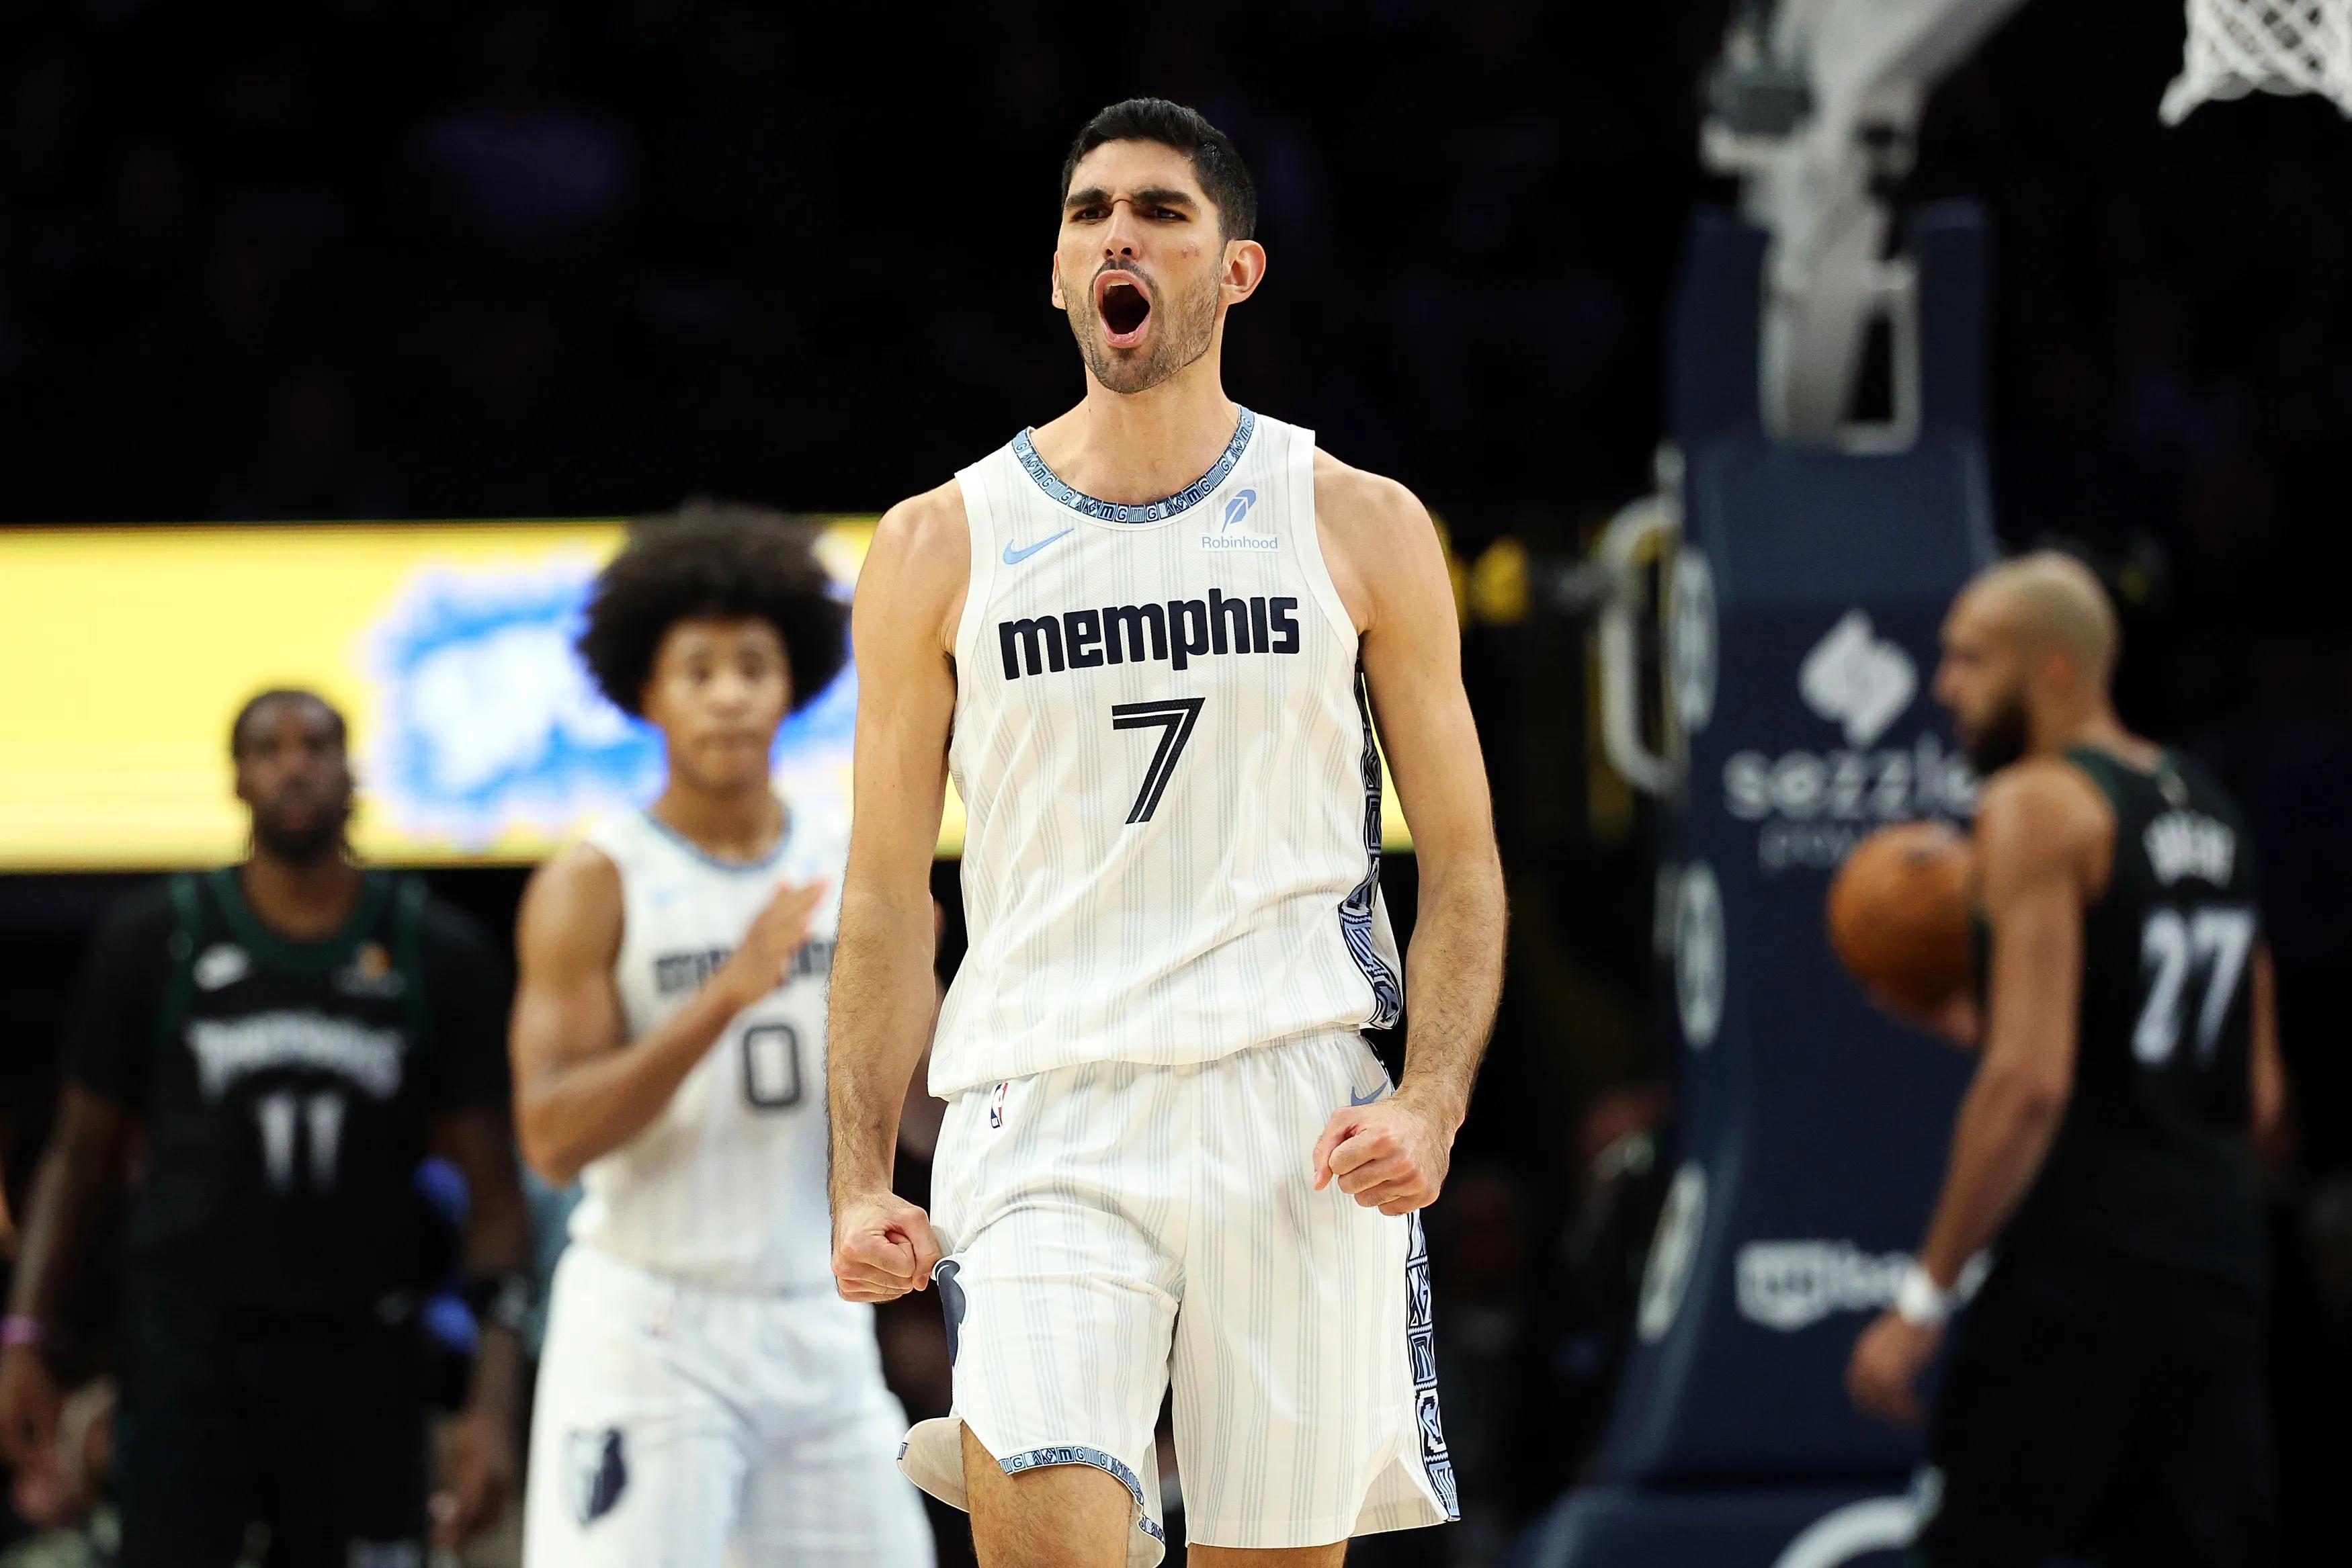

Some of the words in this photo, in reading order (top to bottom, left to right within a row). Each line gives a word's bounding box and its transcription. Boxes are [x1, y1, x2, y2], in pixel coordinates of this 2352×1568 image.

[1202, 535, 1278, 550] Robinhood
[998, 587, 1300, 681] memphis
[1111, 697, 1206, 825] 7
[2130, 904, 2257, 1067] 27
[743, 1022, 803, 1111] 0
[257, 1087, 347, 1196] 11
